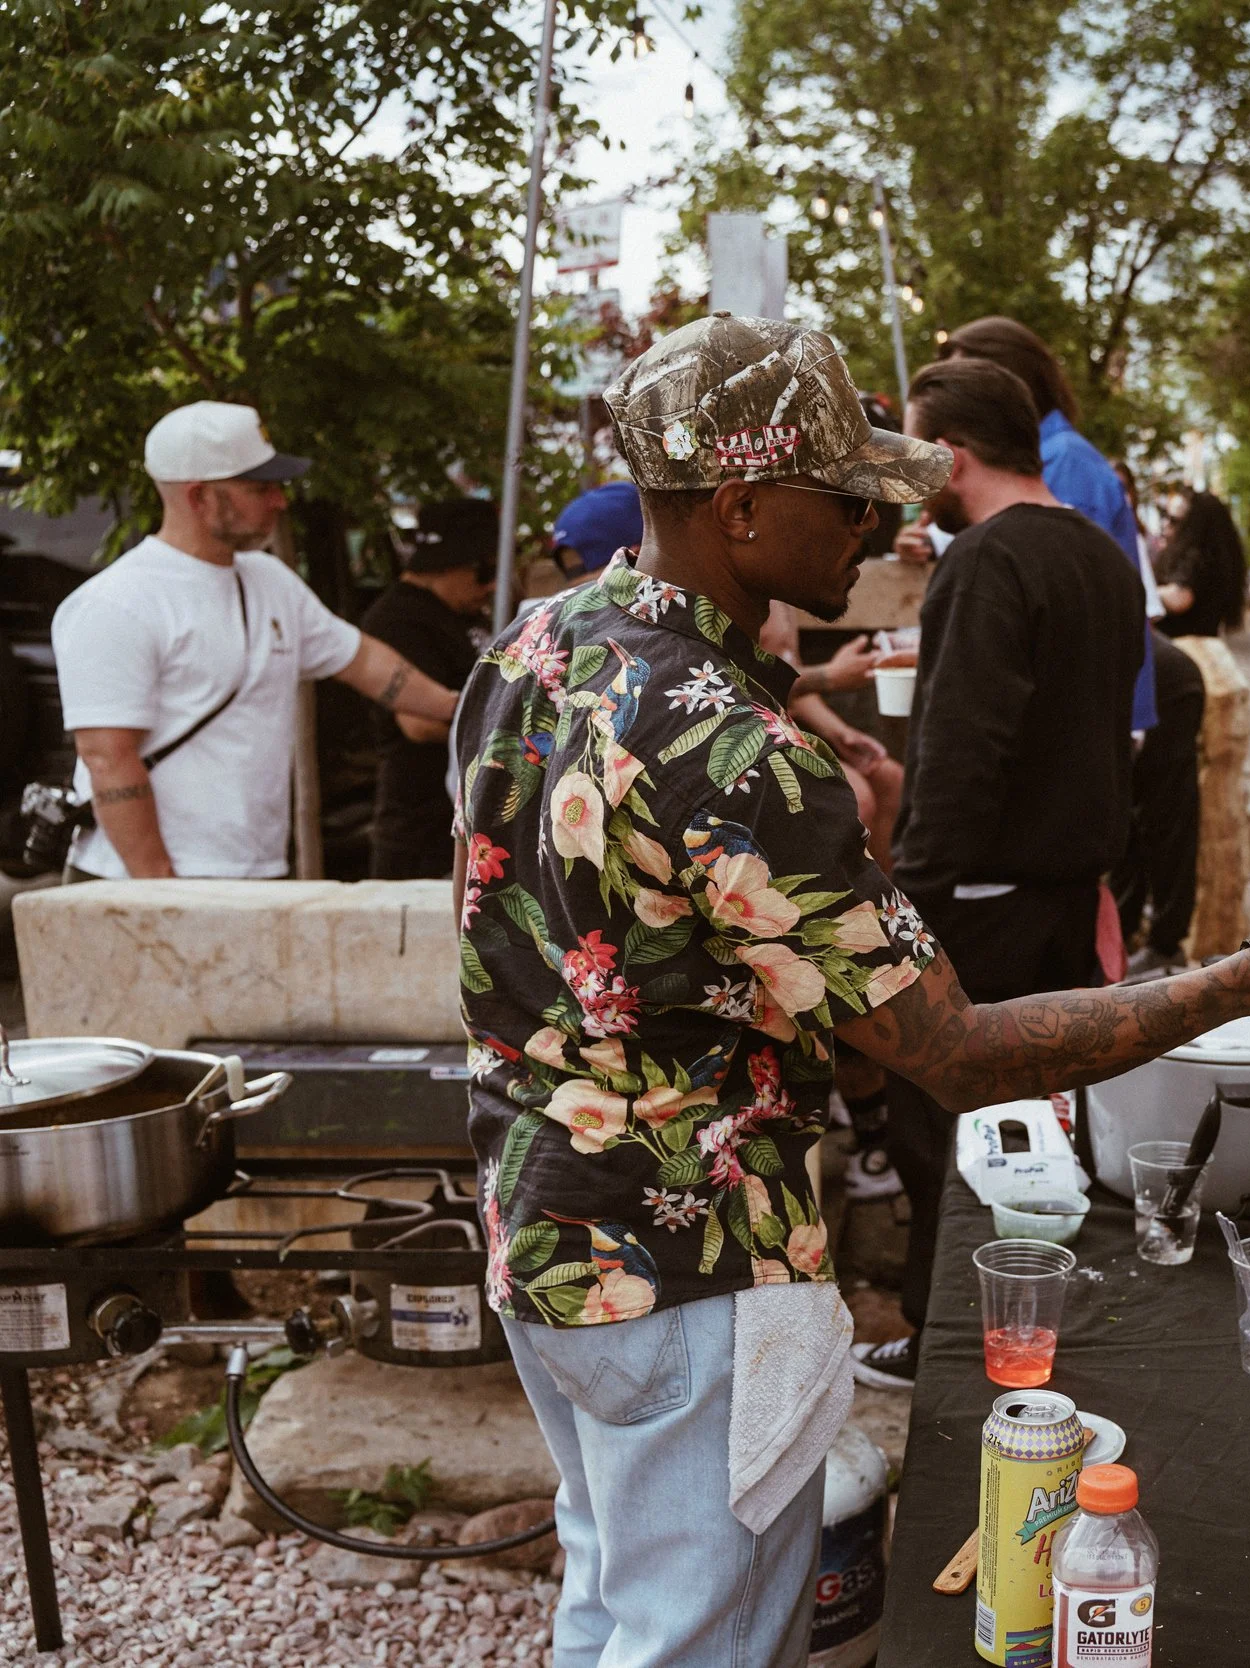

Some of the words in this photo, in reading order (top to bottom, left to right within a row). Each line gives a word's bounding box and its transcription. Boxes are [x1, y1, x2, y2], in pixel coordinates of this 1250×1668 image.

[769, 435, 796, 446] BOWL
[987, 1433, 1002, 1447] 21+
[1024, 1469, 1079, 1523] AriZ
[1034, 1508, 1063, 1527] PREMIUM
[1077, 1627, 1150, 1645] GATORLYTE
[1104, 1645, 1147, 1653] REHYDRATION
